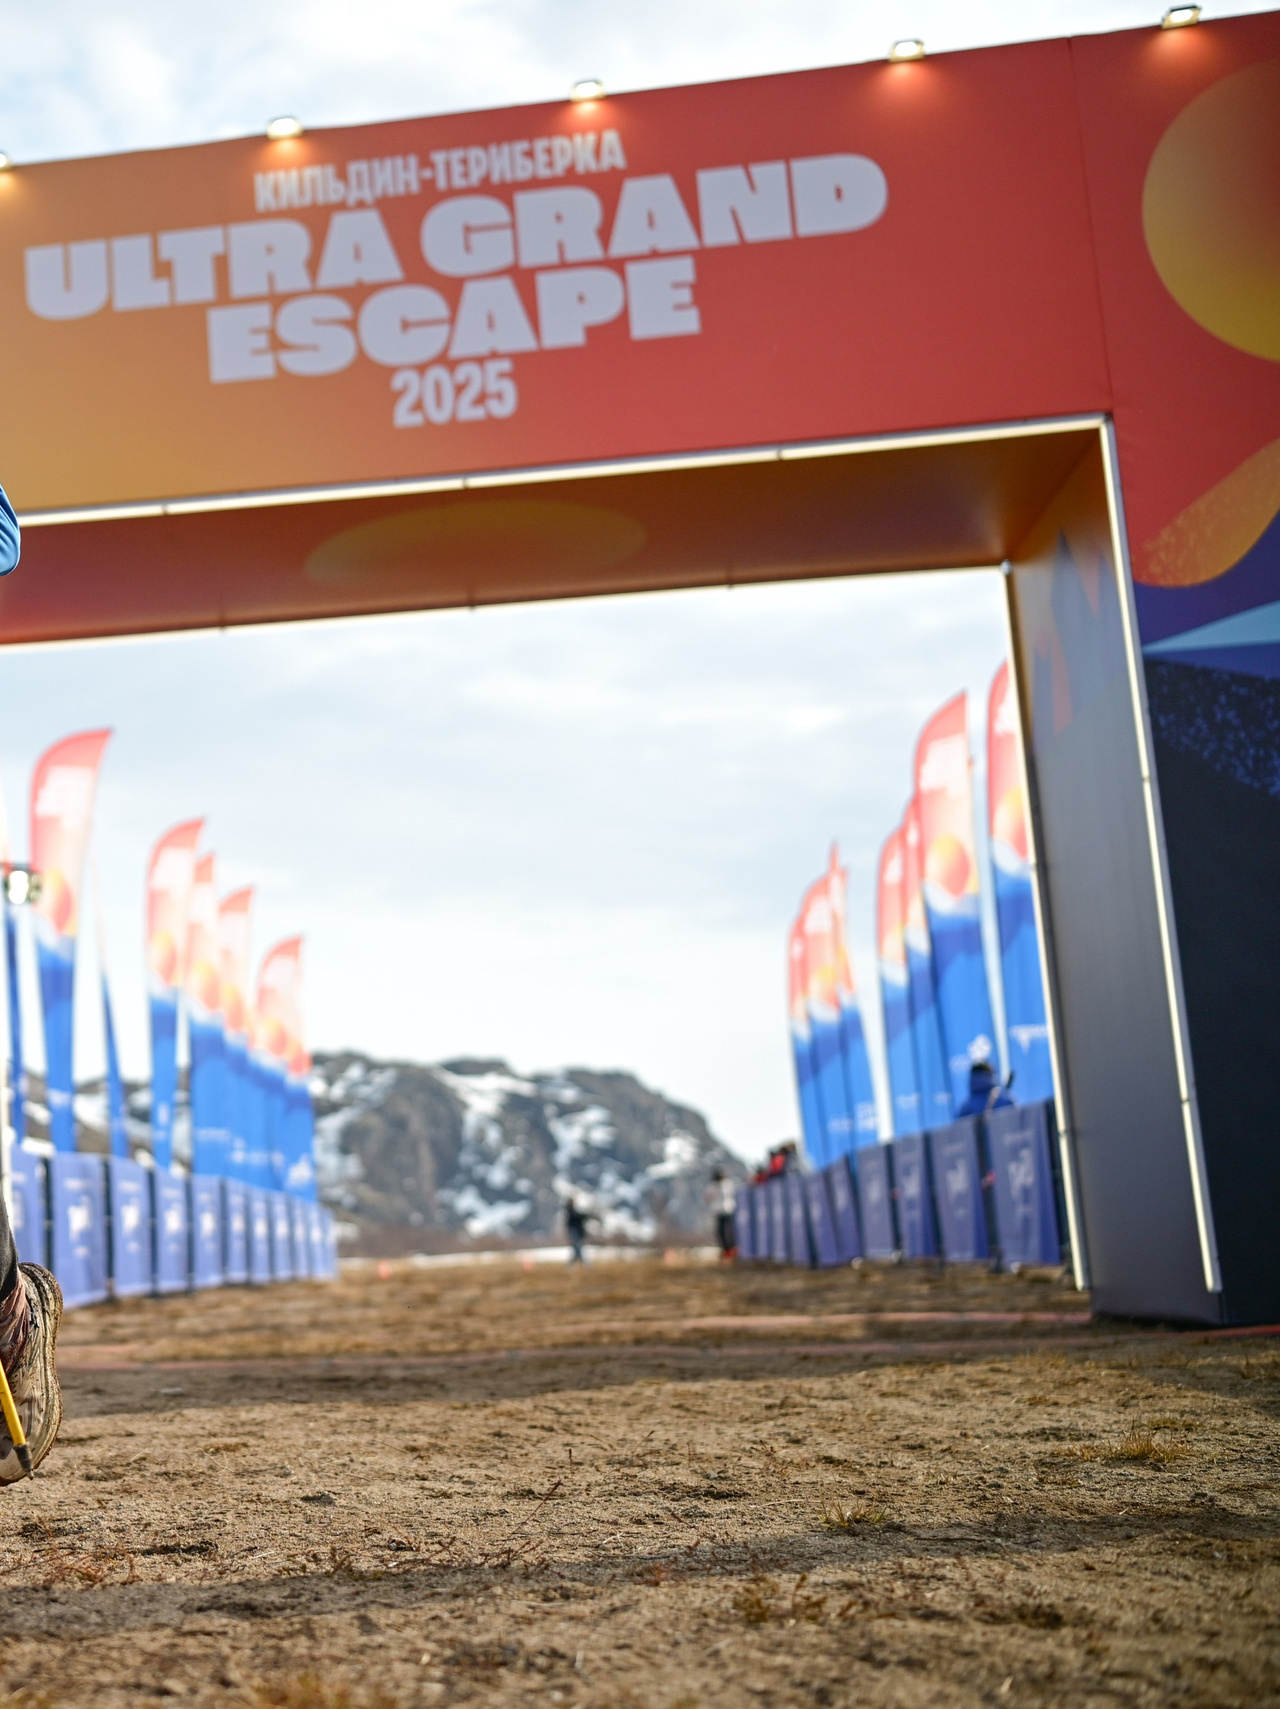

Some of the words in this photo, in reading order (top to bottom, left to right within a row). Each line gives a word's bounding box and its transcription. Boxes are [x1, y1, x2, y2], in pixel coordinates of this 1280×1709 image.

[254, 128, 626, 213] КИЛЬДИН-ТЕРИБЕРКА
[24, 209, 404, 320] ULTRA
[420, 153, 888, 277] GRAND
[206, 255, 701, 384] ESCAPE
[391, 359, 517, 428] 2025
